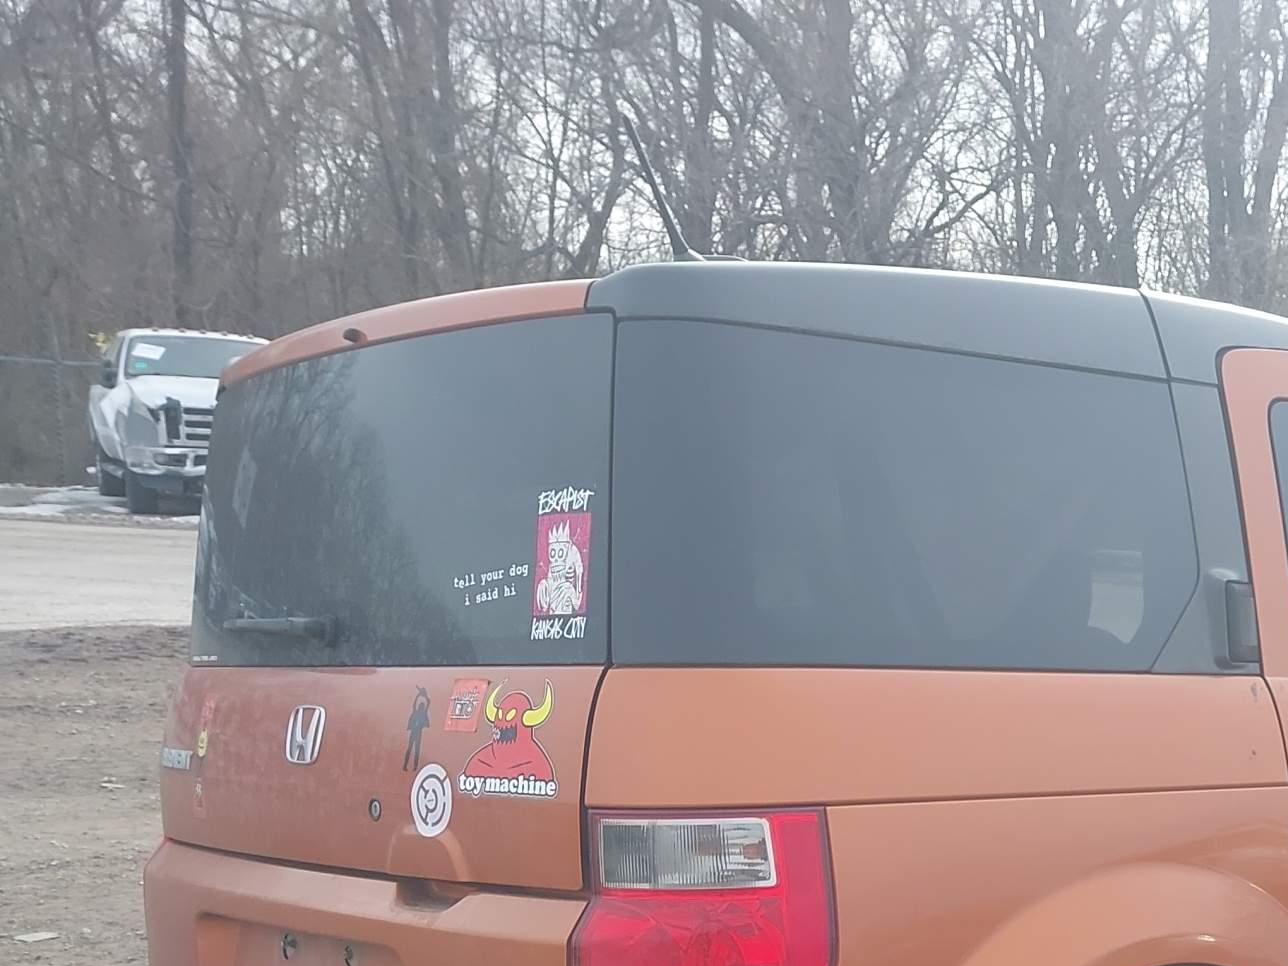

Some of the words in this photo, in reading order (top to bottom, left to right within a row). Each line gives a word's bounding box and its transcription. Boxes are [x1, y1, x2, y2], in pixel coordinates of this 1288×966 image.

[538, 486, 595, 515] ESCAPIST
[454, 573, 476, 588] tell
[480, 569, 504, 585] your
[509, 564, 529, 577] dog
[464, 593, 470, 606] i
[475, 587, 499, 603] said
[503, 582, 516, 597] hi
[530, 617, 564, 641] KANSAS
[563, 616, 587, 639] CITY
